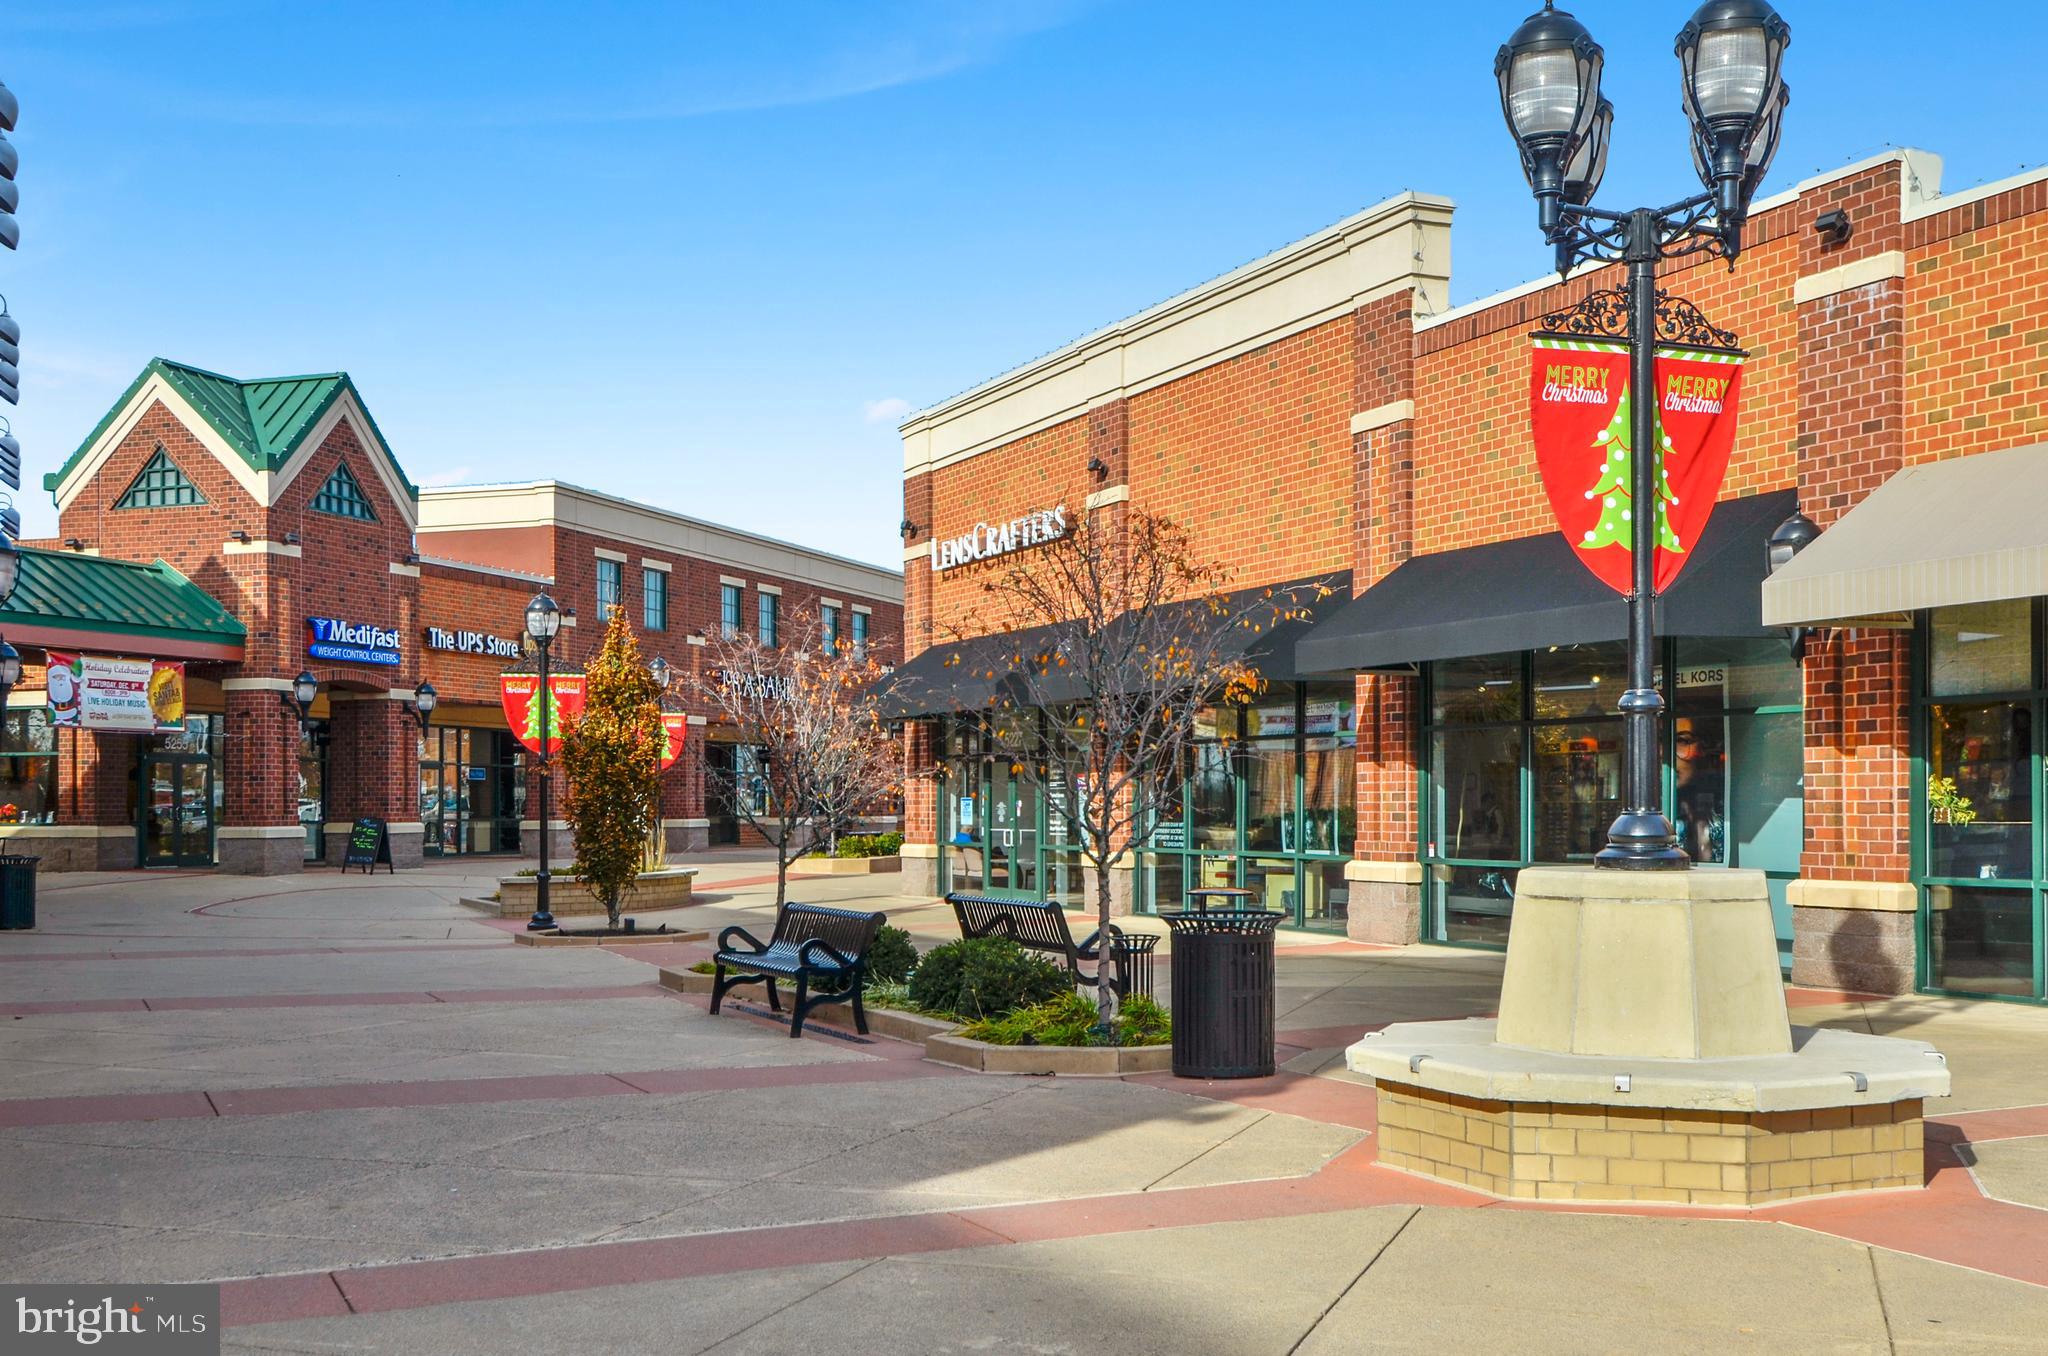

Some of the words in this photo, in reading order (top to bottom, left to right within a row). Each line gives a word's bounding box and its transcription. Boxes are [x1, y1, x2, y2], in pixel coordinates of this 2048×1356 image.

[1545, 364, 1610, 388] MERRY
[1667, 374, 1730, 399] MERRY
[1542, 382, 1608, 405] Christmas
[329, 619, 400, 650] Medifast
[429, 627, 455, 649] The
[457, 630, 484, 653] UPS
[486, 634, 519, 658] Store
[317, 646, 341, 657] WEIGHT
[342, 649, 371, 660] CONTROL
[84, 661, 112, 674] Holiday
[113, 664, 150, 676] Celebration
[1691, 668, 1724, 684] KORS
[87, 697, 100, 705] LIVE
[101, 698, 125, 707] HOLIDAY
[127, 699, 146, 709] MUSIC
